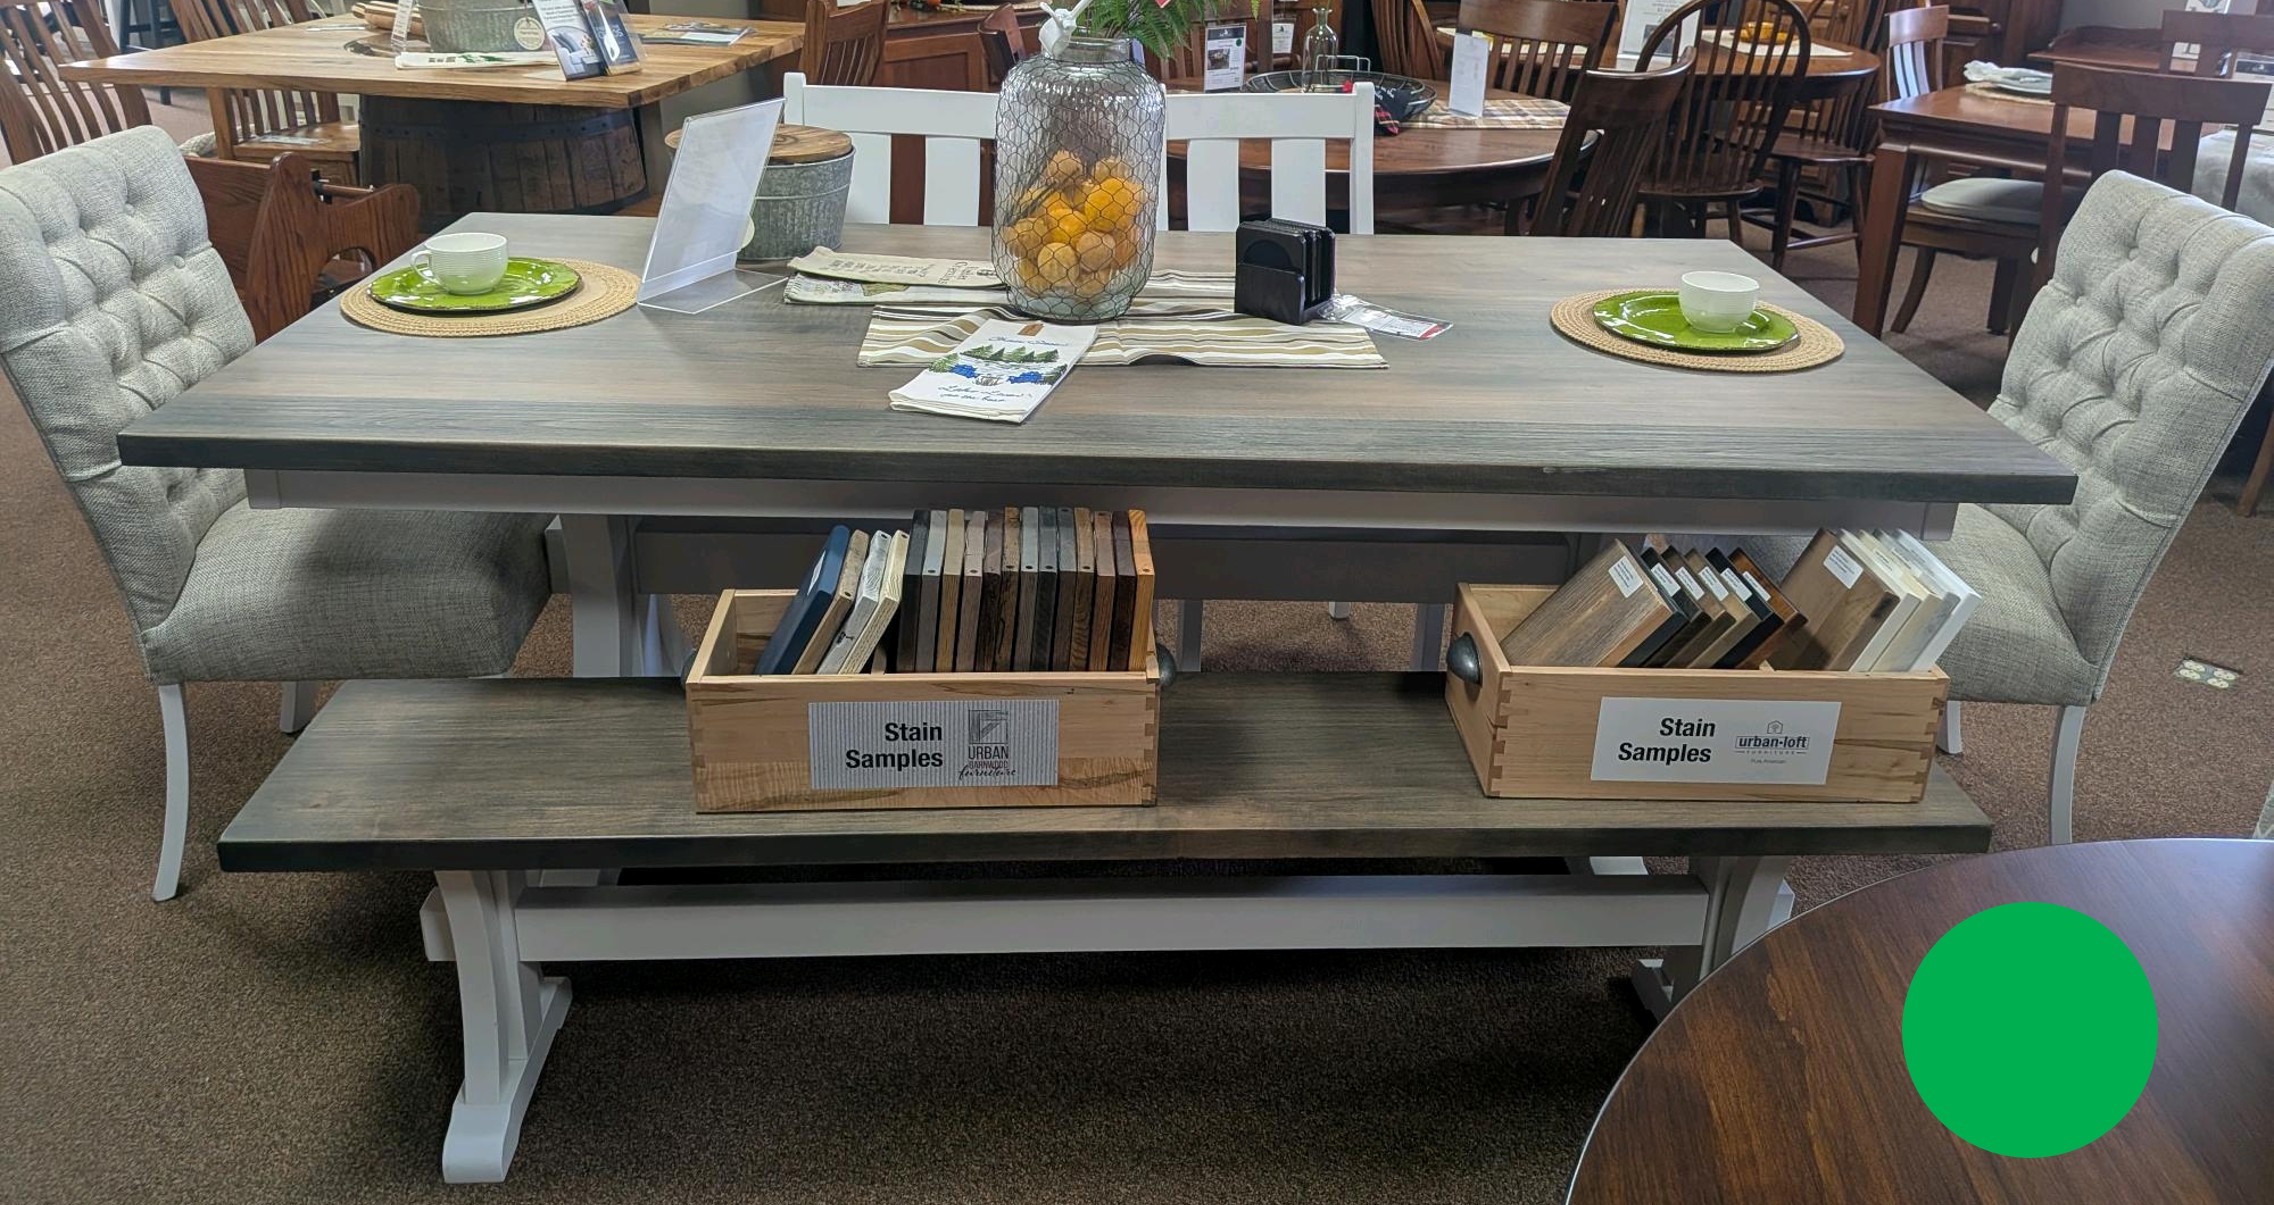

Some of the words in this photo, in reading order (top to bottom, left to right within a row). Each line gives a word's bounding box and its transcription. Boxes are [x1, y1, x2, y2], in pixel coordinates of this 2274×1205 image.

[885, 722, 943, 742] Stain
[1659, 718, 1716, 738] Stain
[845, 749, 944, 772] Samples
[968, 745, 1009, 760] URBAN
[1618, 742, 1712, 766] Samples
